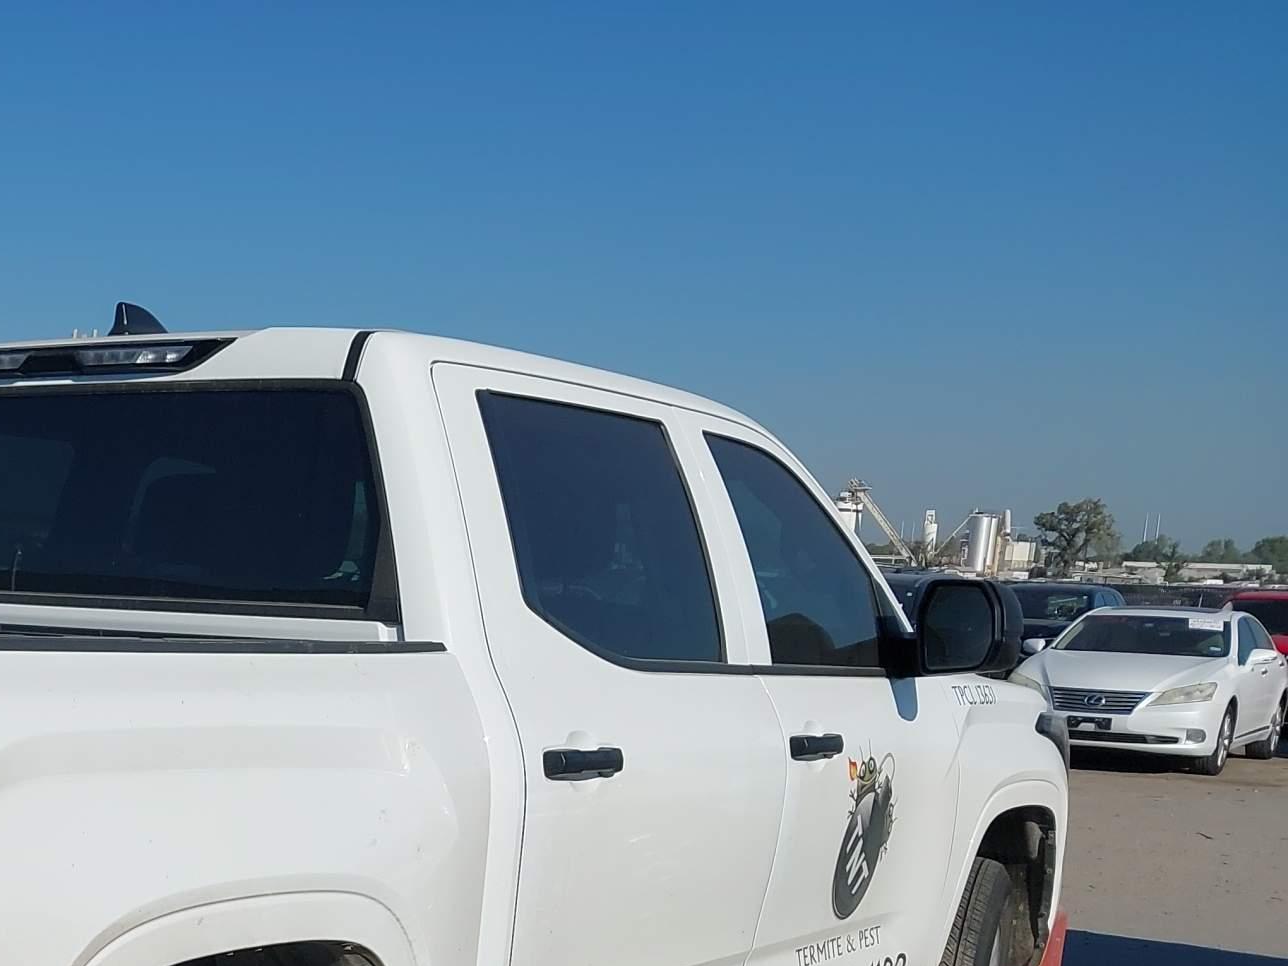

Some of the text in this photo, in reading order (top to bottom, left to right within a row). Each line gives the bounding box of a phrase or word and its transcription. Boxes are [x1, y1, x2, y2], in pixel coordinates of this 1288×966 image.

[846, 814, 869, 895] TNT
[846, 934, 856, 953] &
[858, 925, 881, 950] PEST
